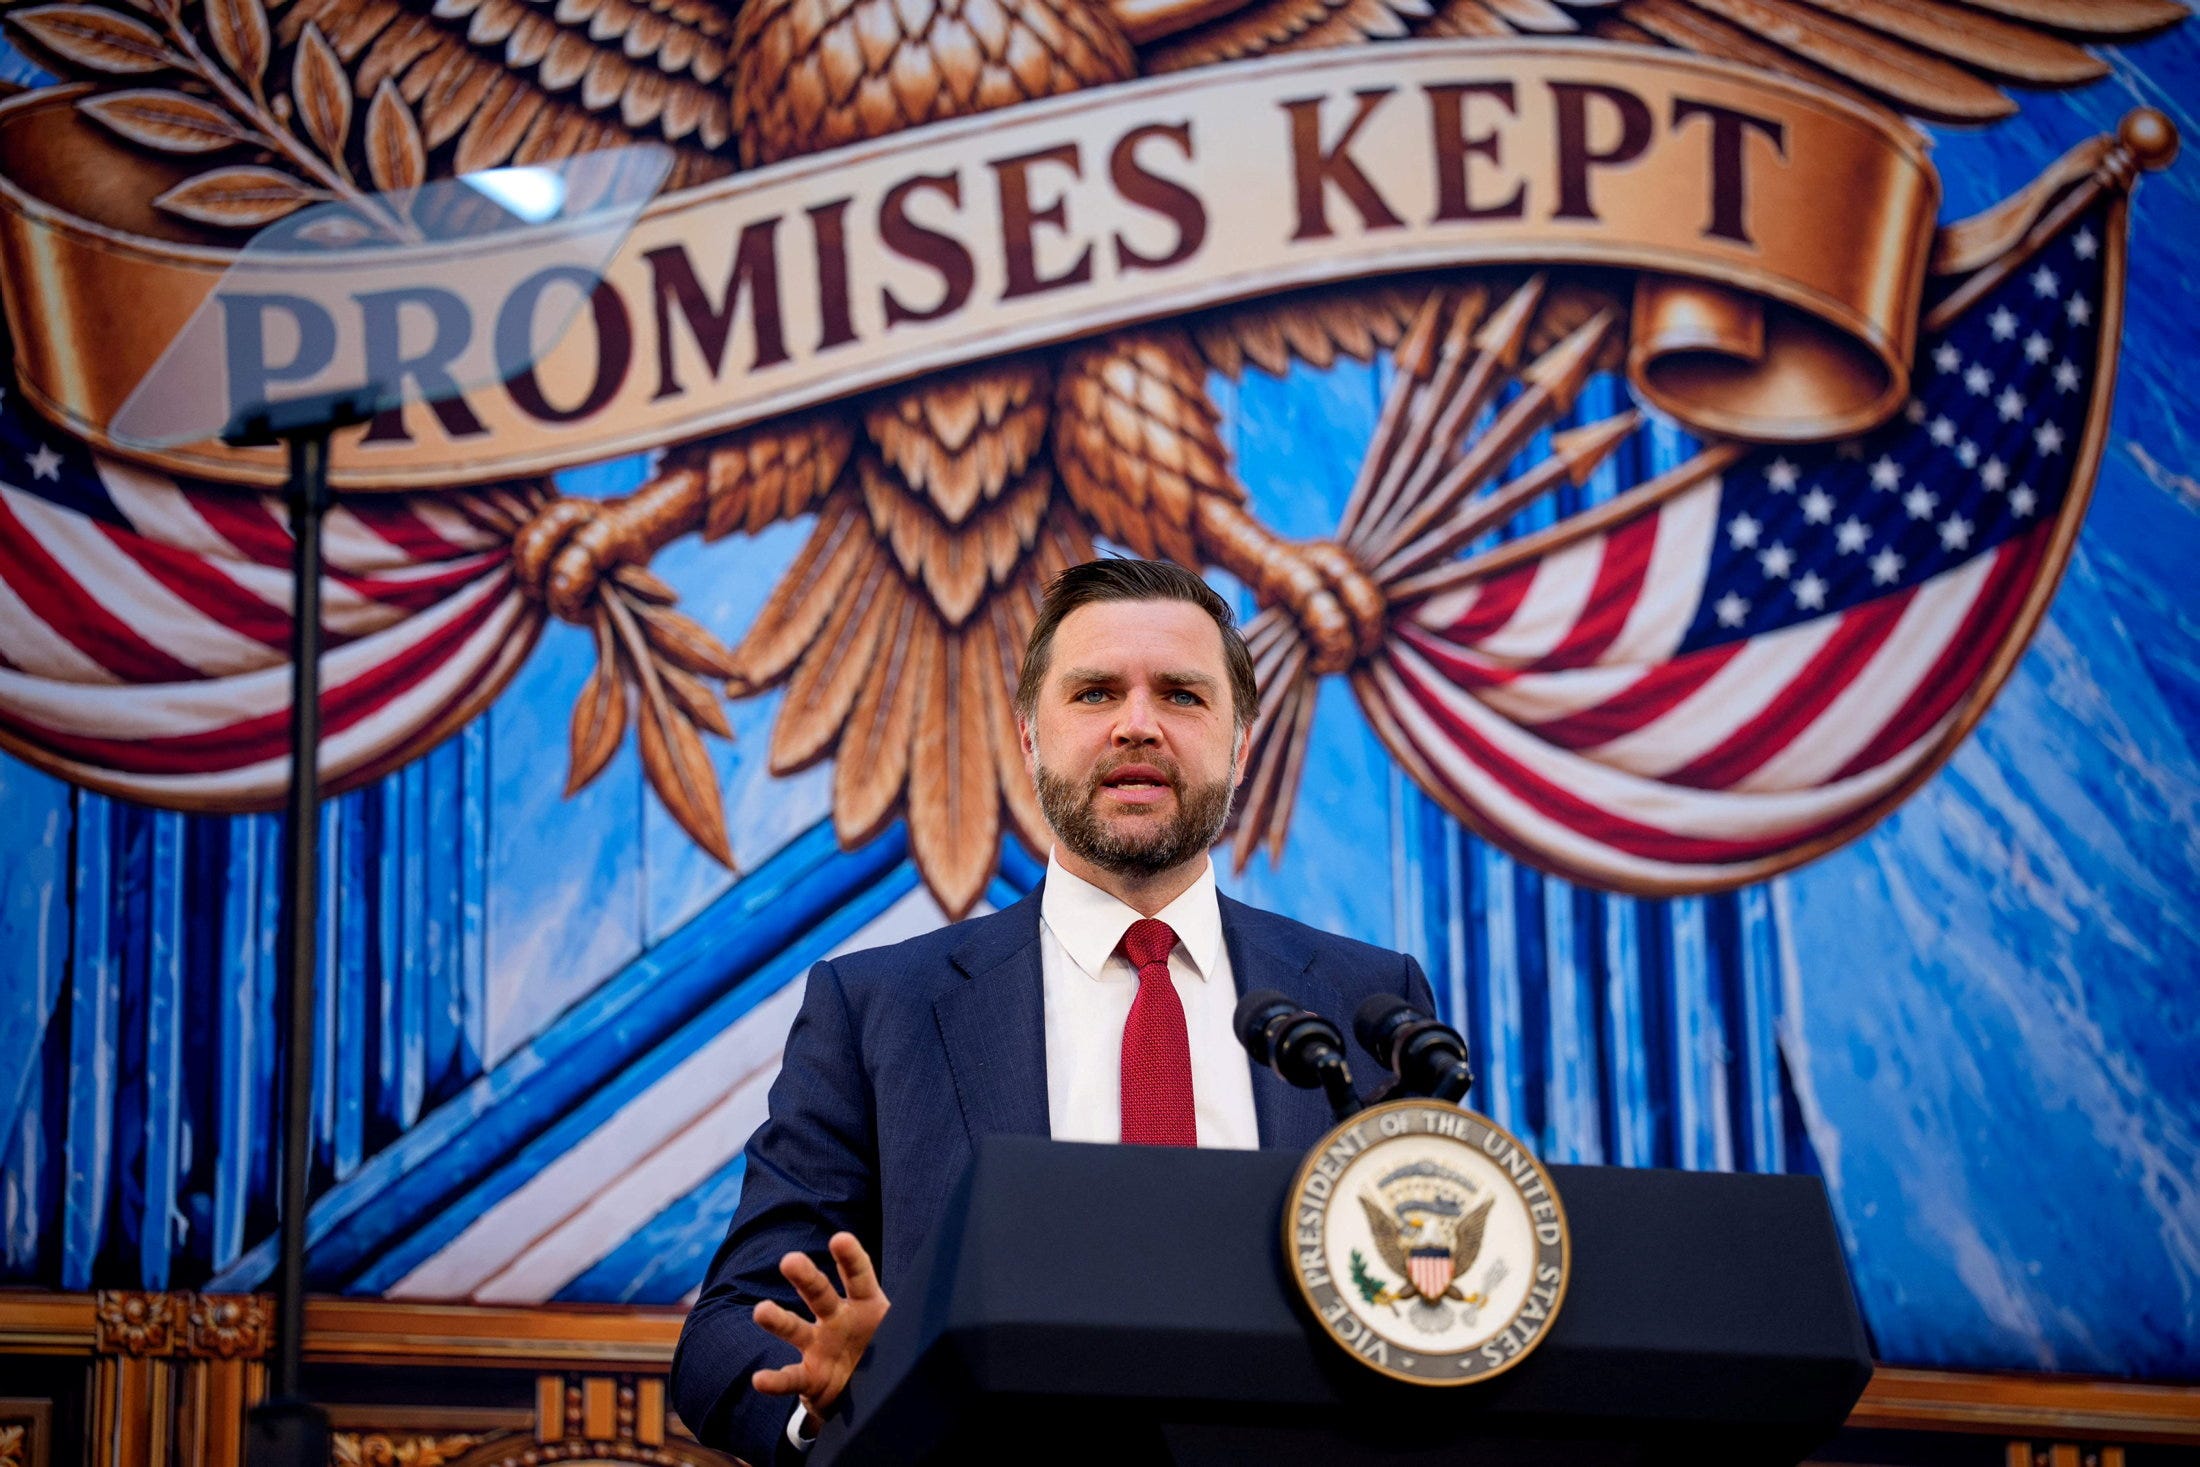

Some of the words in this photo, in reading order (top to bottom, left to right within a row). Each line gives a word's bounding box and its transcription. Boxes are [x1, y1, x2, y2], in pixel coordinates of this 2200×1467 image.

[218, 120, 1206, 446] PROMISES
[1278, 78, 1787, 246] KEPT
[1379, 1114, 1408, 1134] OF
[1422, 1110, 1469, 1138] THE
[1297, 1128, 1369, 1288] PRESIDENT
[1481, 1130, 1560, 1245] UNITED
[1321, 1300, 1389, 1366] VICE
[1480, 1262, 1560, 1367] STATES
